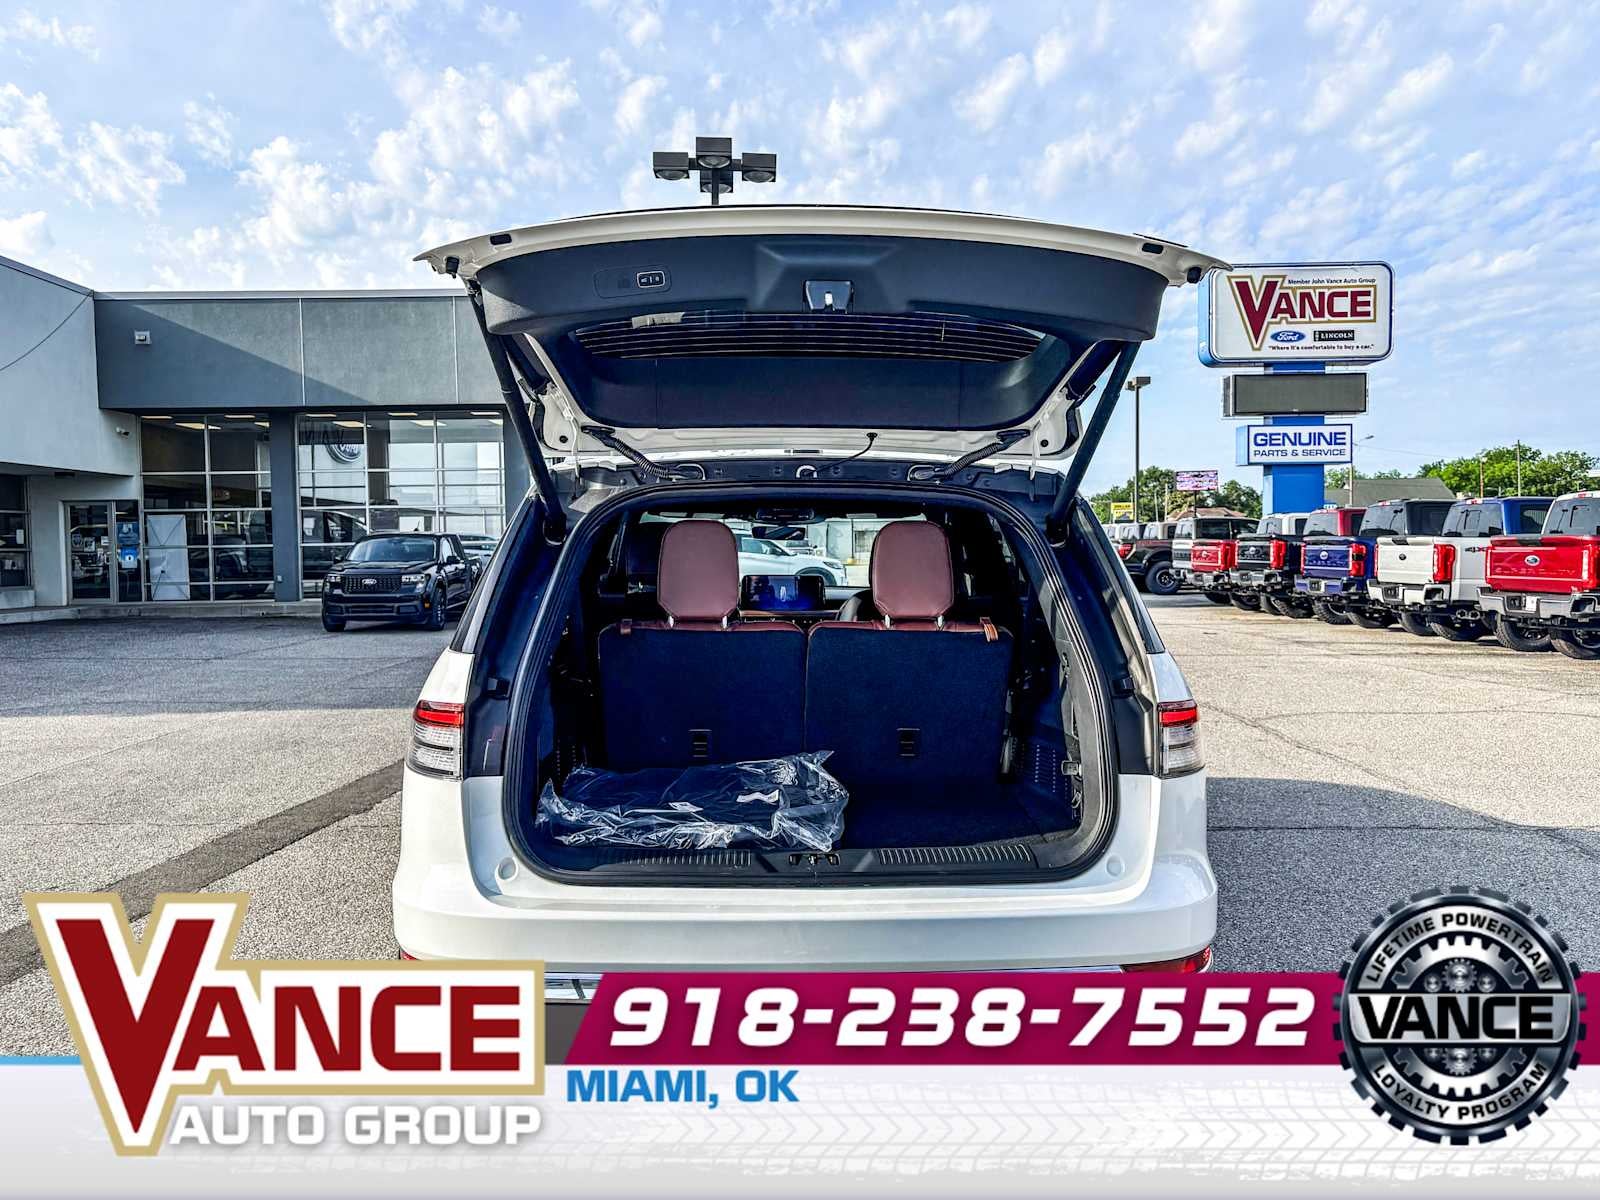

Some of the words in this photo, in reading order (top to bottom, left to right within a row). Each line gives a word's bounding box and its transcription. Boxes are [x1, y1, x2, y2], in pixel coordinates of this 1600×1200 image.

[1235, 280, 1372, 345] VANCE
[1274, 331, 1301, 342] Ford
[1320, 331, 1353, 339] LINCOLN
[1253, 432, 1347, 447] GENUINE
[1253, 449, 1288, 457] PARTS
